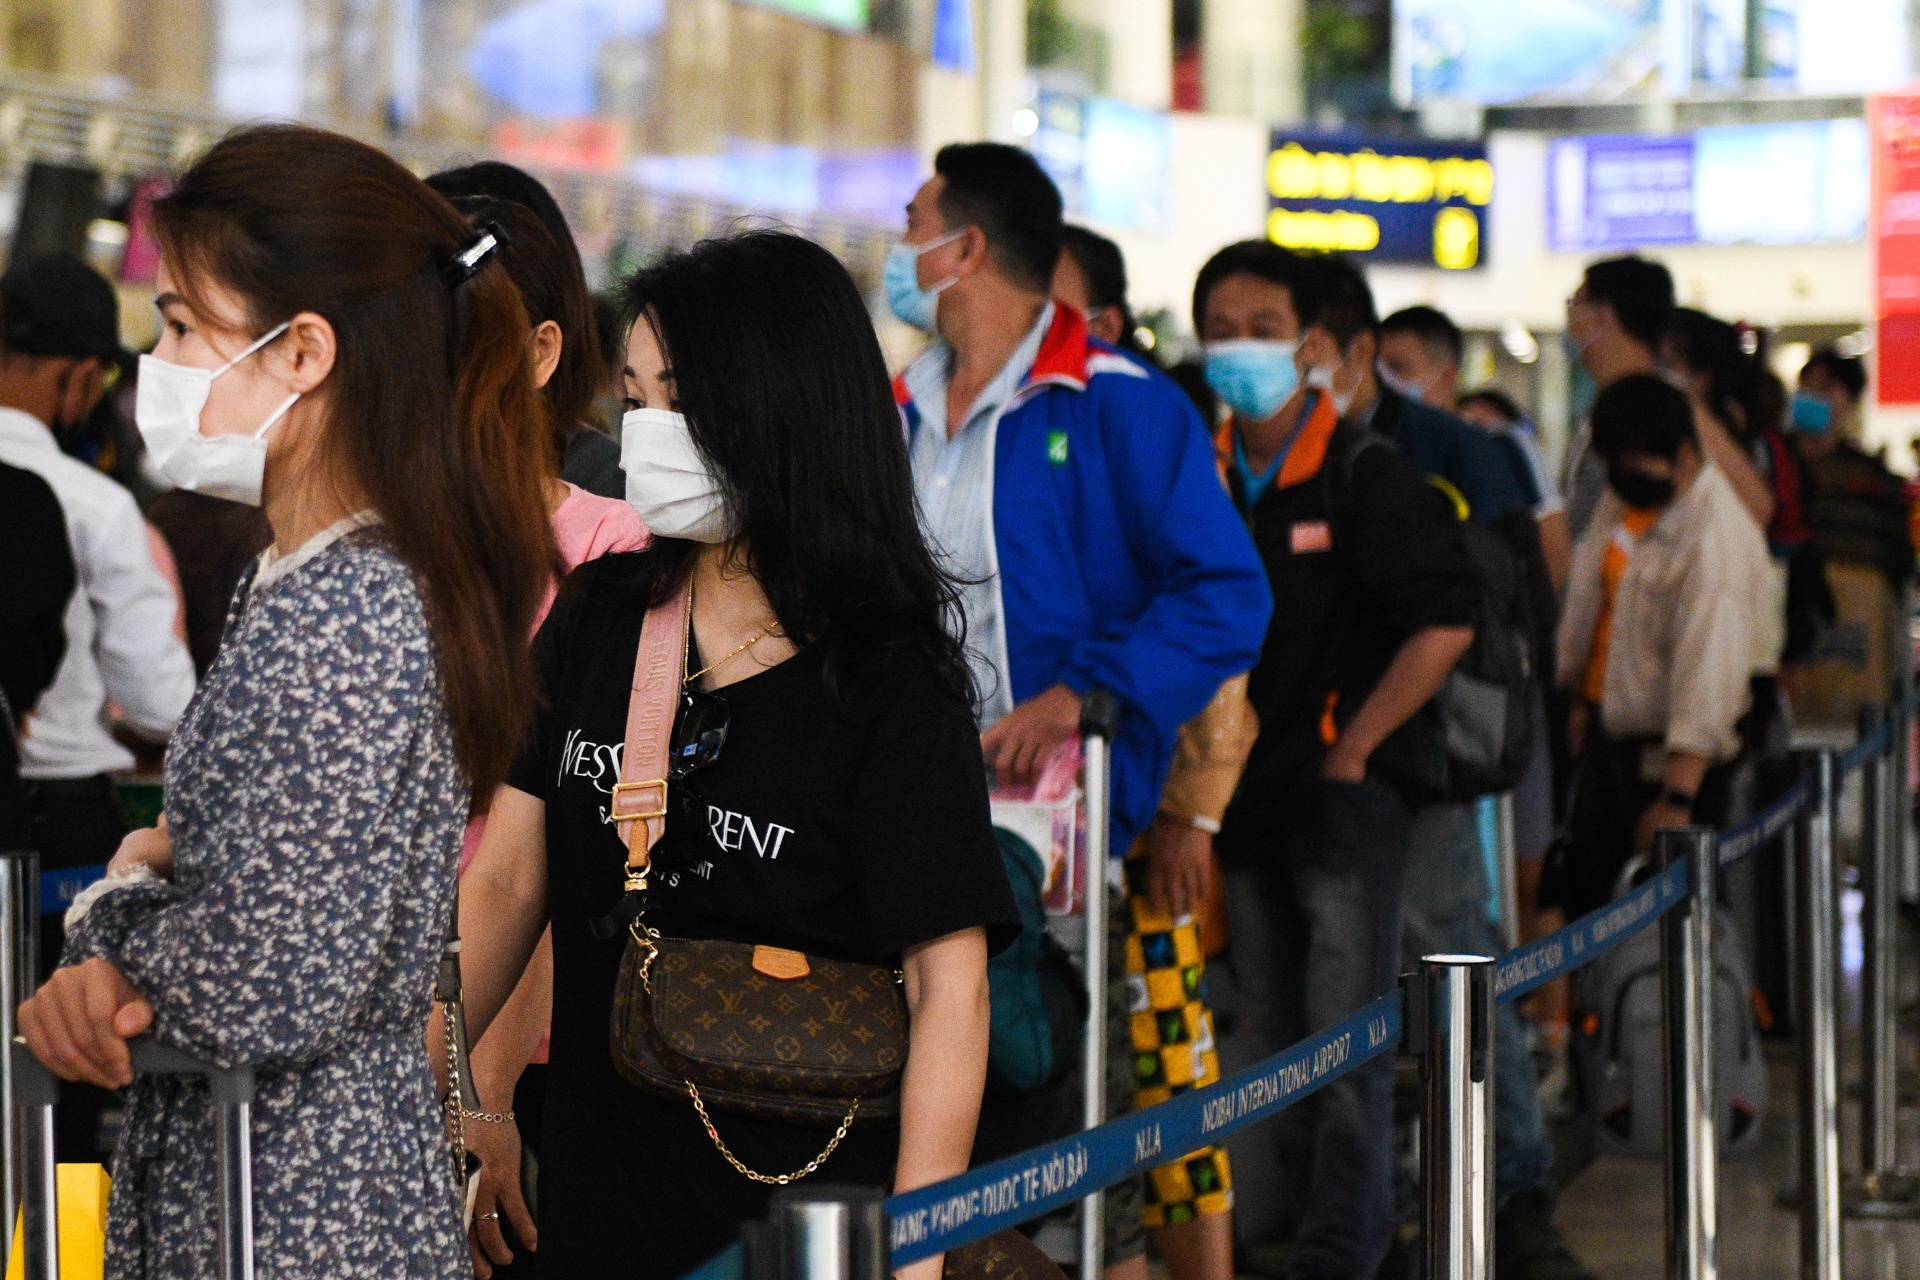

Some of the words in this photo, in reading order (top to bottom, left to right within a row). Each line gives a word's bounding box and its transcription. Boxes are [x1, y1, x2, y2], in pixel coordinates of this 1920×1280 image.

[708, 805, 795, 860] RENT
[1237, 1056, 1310, 1119] INTERNATIONAL
[1312, 1033, 1350, 1081] AIRPORT
